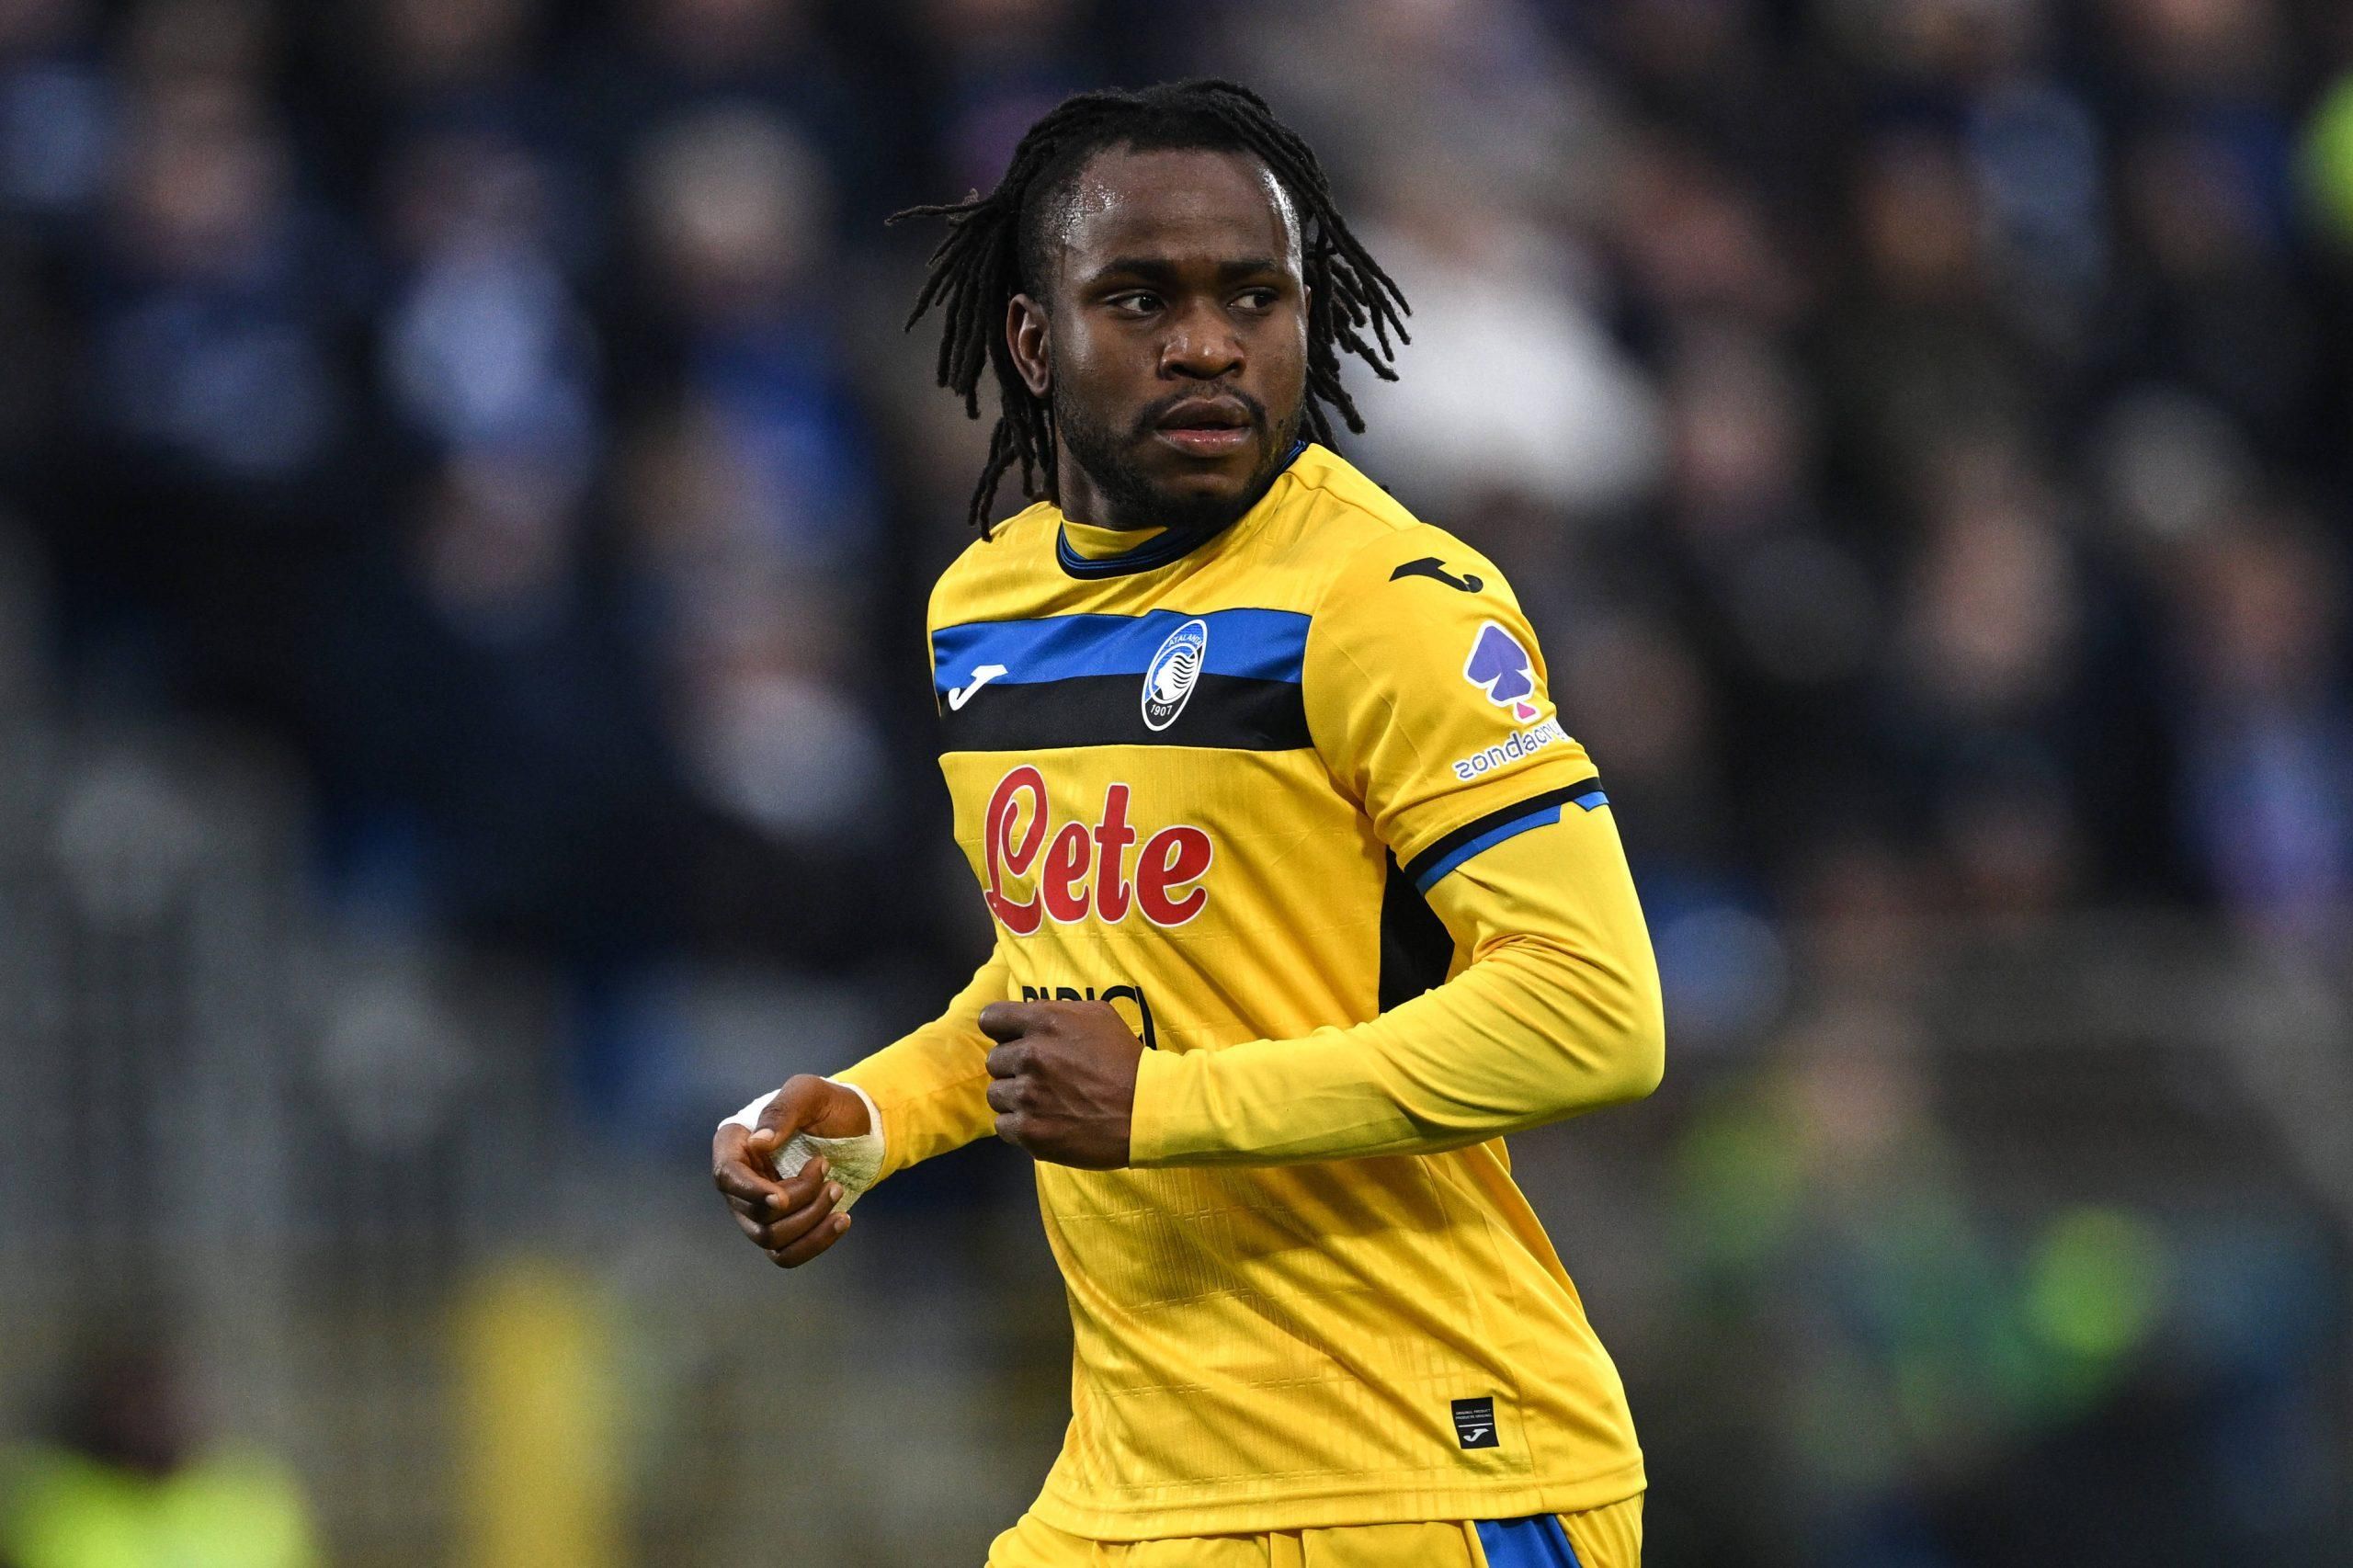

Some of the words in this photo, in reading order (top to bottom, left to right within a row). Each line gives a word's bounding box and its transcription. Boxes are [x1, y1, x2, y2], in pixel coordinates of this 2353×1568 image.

[1168, 633, 1202, 647] ATALANTA
[1150, 704, 1173, 717] 1907
[983, 764, 1213, 937] Lete
